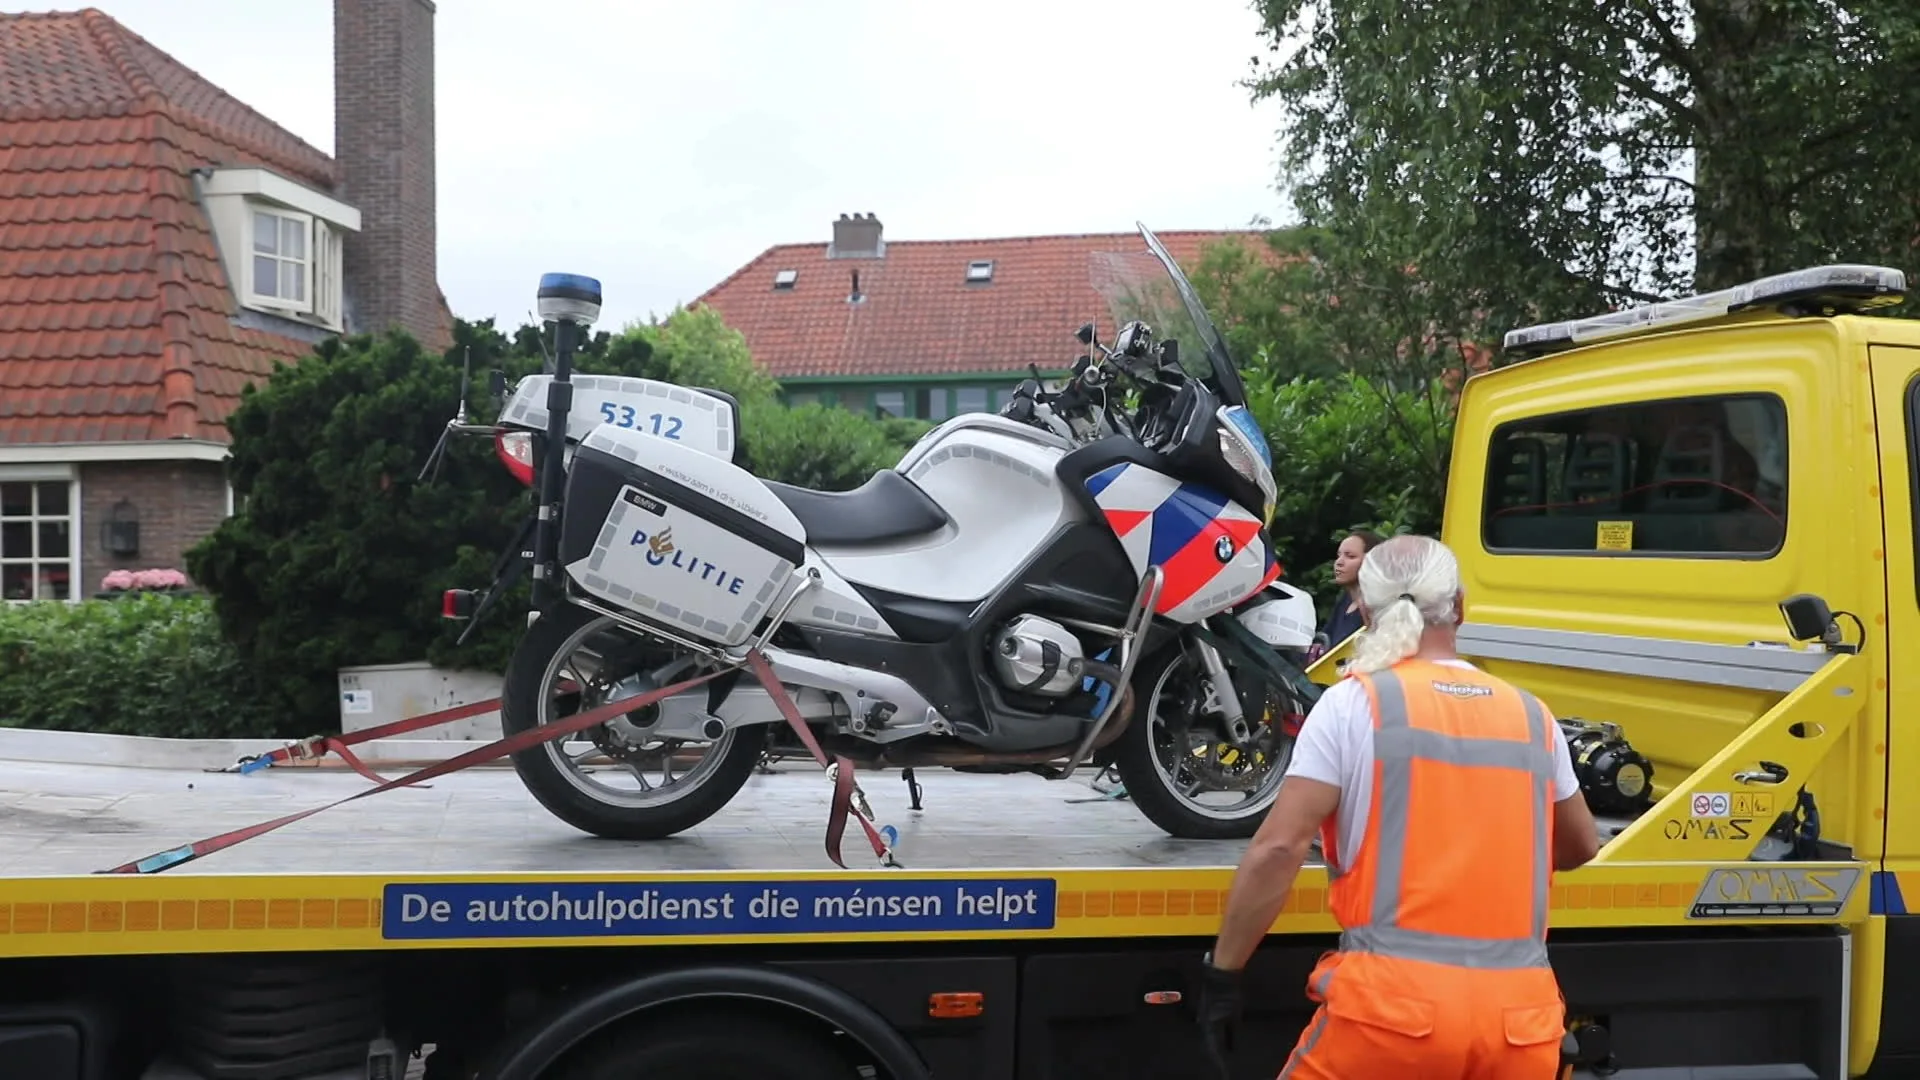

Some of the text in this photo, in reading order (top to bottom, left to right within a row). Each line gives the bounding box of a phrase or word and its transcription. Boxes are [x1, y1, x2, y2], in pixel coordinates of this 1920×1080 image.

[600, 402, 683, 440] 53.12
[633, 494, 658, 511] BMW
[630, 529, 745, 595] POLITIE
[402, 887, 1038, 928] De autohulpdienst die ménsen helpt
